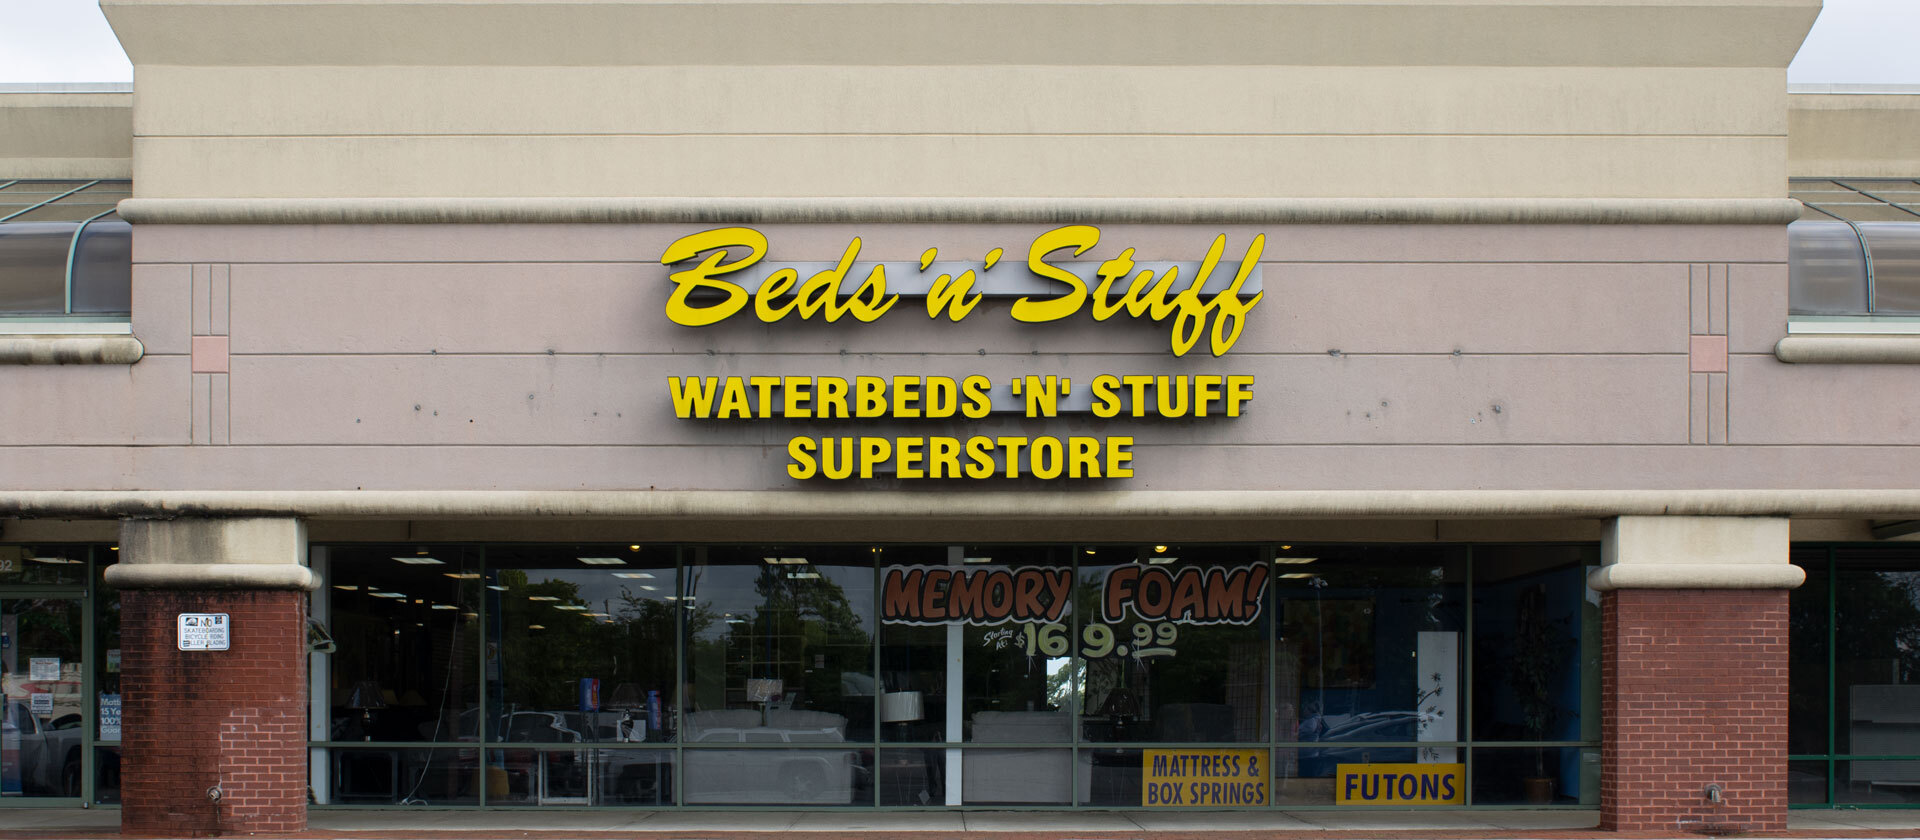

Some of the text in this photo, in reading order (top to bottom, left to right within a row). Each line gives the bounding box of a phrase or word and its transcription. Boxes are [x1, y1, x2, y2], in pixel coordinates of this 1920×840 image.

[660, 226, 900, 327] Beds
[1009, 224, 1266, 358] Stuff
[667, 374, 1256, 420] WATERBEDS 'N' STUFF
[786, 435, 1136, 480] SUPERSTORE
[882, 563, 1269, 622] MEMORY FOAM!
[200, 618, 212, 627] NO
[983, 627, 1014, 646] Starting
[1152, 755, 1260, 777] MATTRESS &
[1148, 782, 1264, 804] BOX SPRINGS
[1345, 773, 1455, 801] FUTONS
